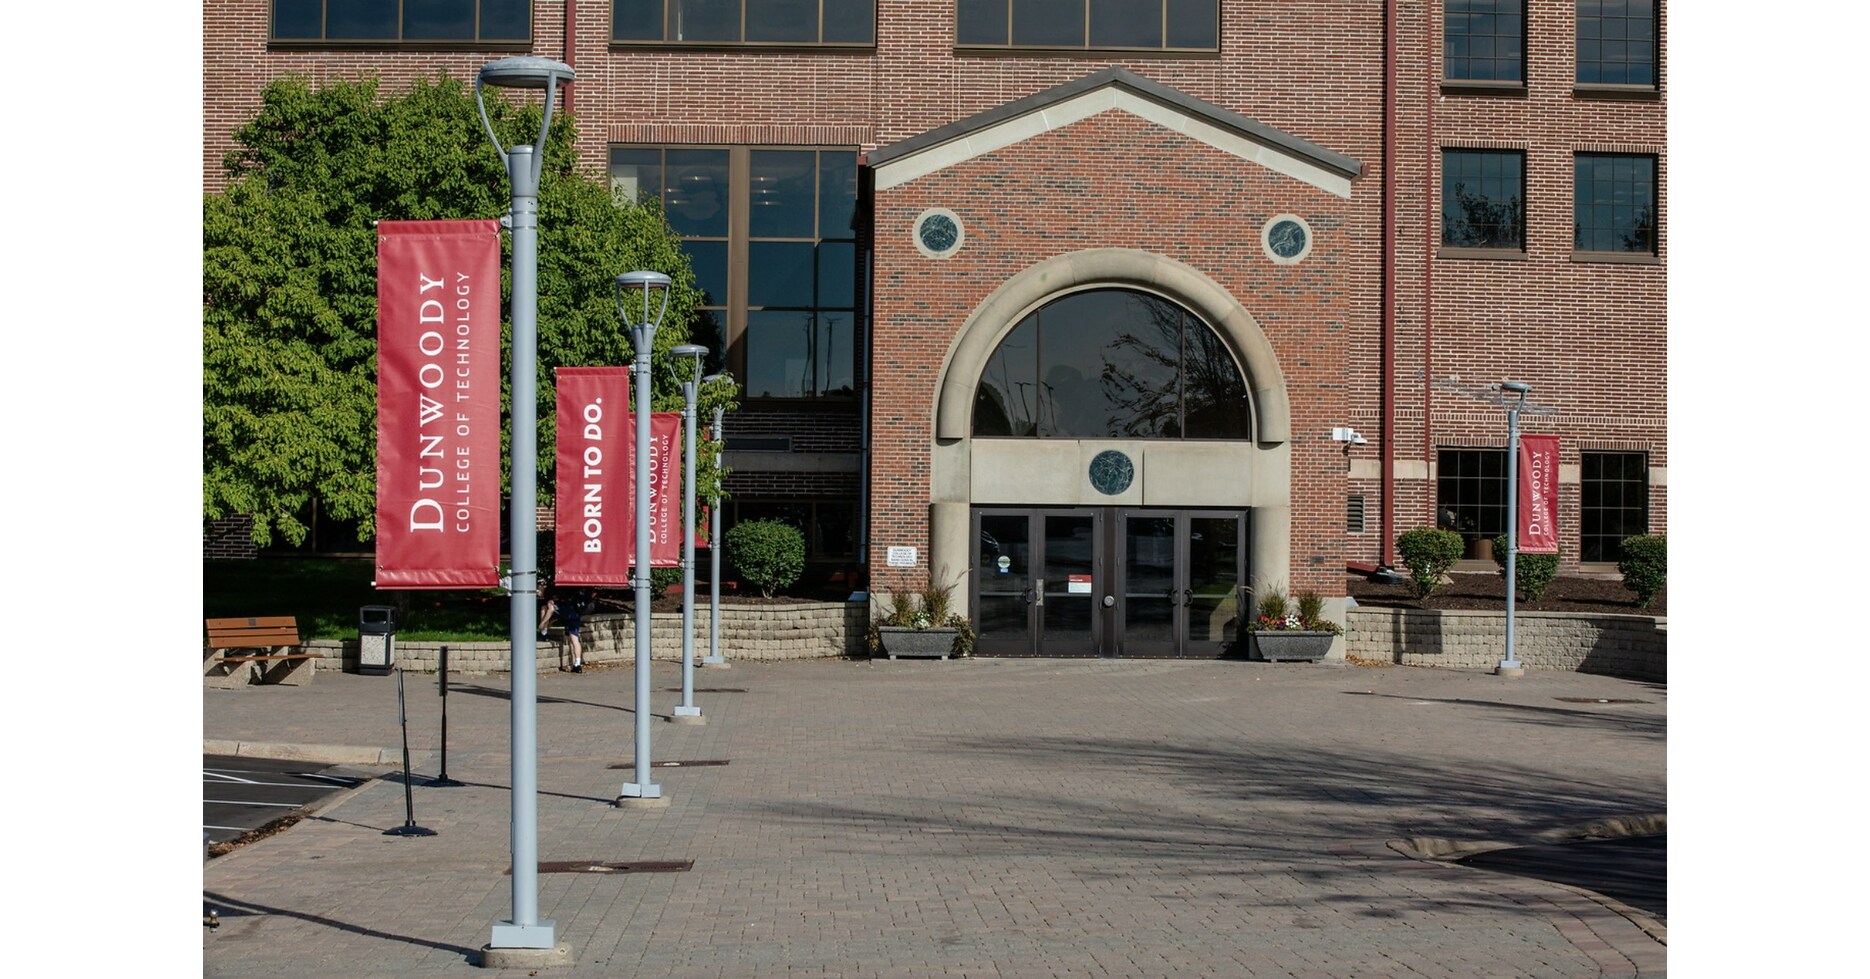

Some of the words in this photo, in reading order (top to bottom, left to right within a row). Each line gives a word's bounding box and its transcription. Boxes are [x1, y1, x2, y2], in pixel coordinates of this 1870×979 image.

[456, 271, 470, 402] TECHNOLOGY
[410, 272, 445, 533] DUNWOODY
[456, 412, 470, 437] OF
[583, 397, 603, 441] DO.
[583, 446, 603, 479] TO
[661, 434, 669, 490] TECHNOLOGY
[456, 446, 470, 533] COLLEGE
[661, 494, 668, 504] OF
[1529, 451, 1542, 536] DUNWOODY
[1543, 496, 1549, 505] OF
[583, 483, 603, 553] BORN
[660, 508, 668, 545] COLLEGE
